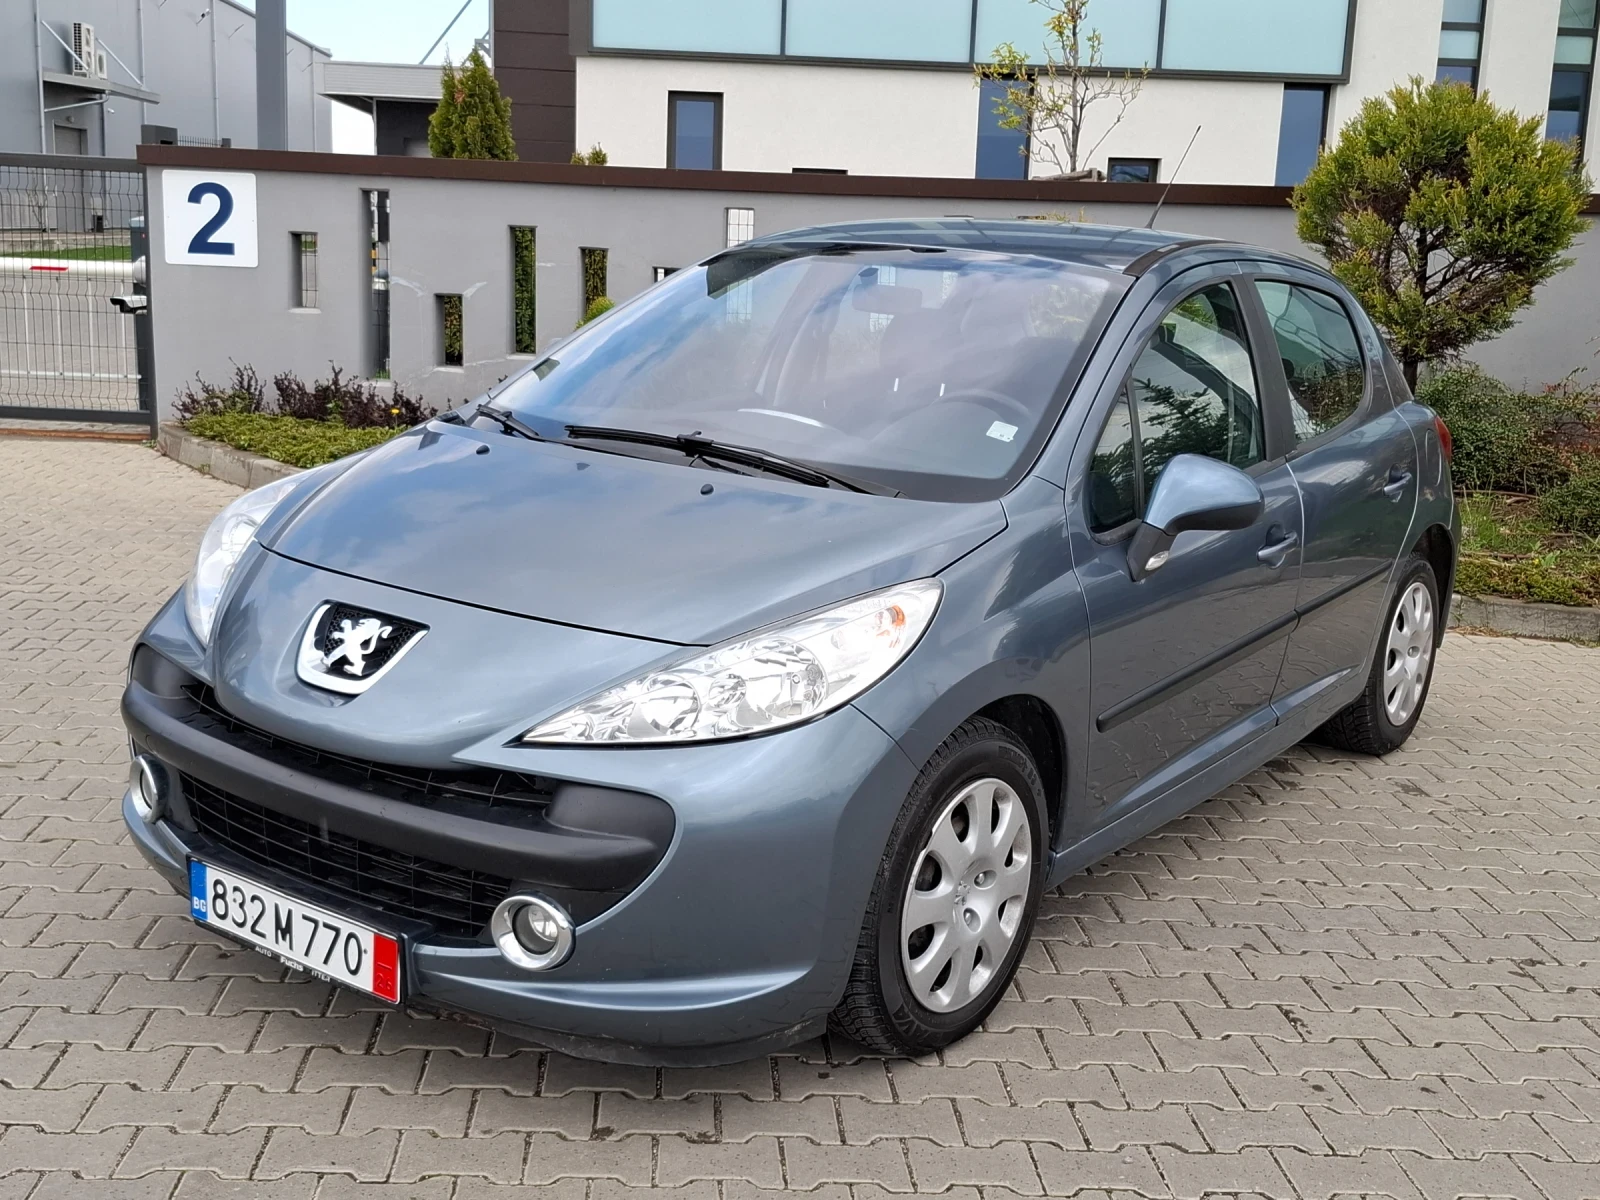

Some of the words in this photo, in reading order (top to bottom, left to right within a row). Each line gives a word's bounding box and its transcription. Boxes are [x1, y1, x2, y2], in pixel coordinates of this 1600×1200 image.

[188, 182, 235, 256] 2
[193, 896, 207, 912] BG
[255, 945, 272, 957] AUTO
[280, 956, 304, 972] Fuchs
[376, 973, 392, 990] 26
